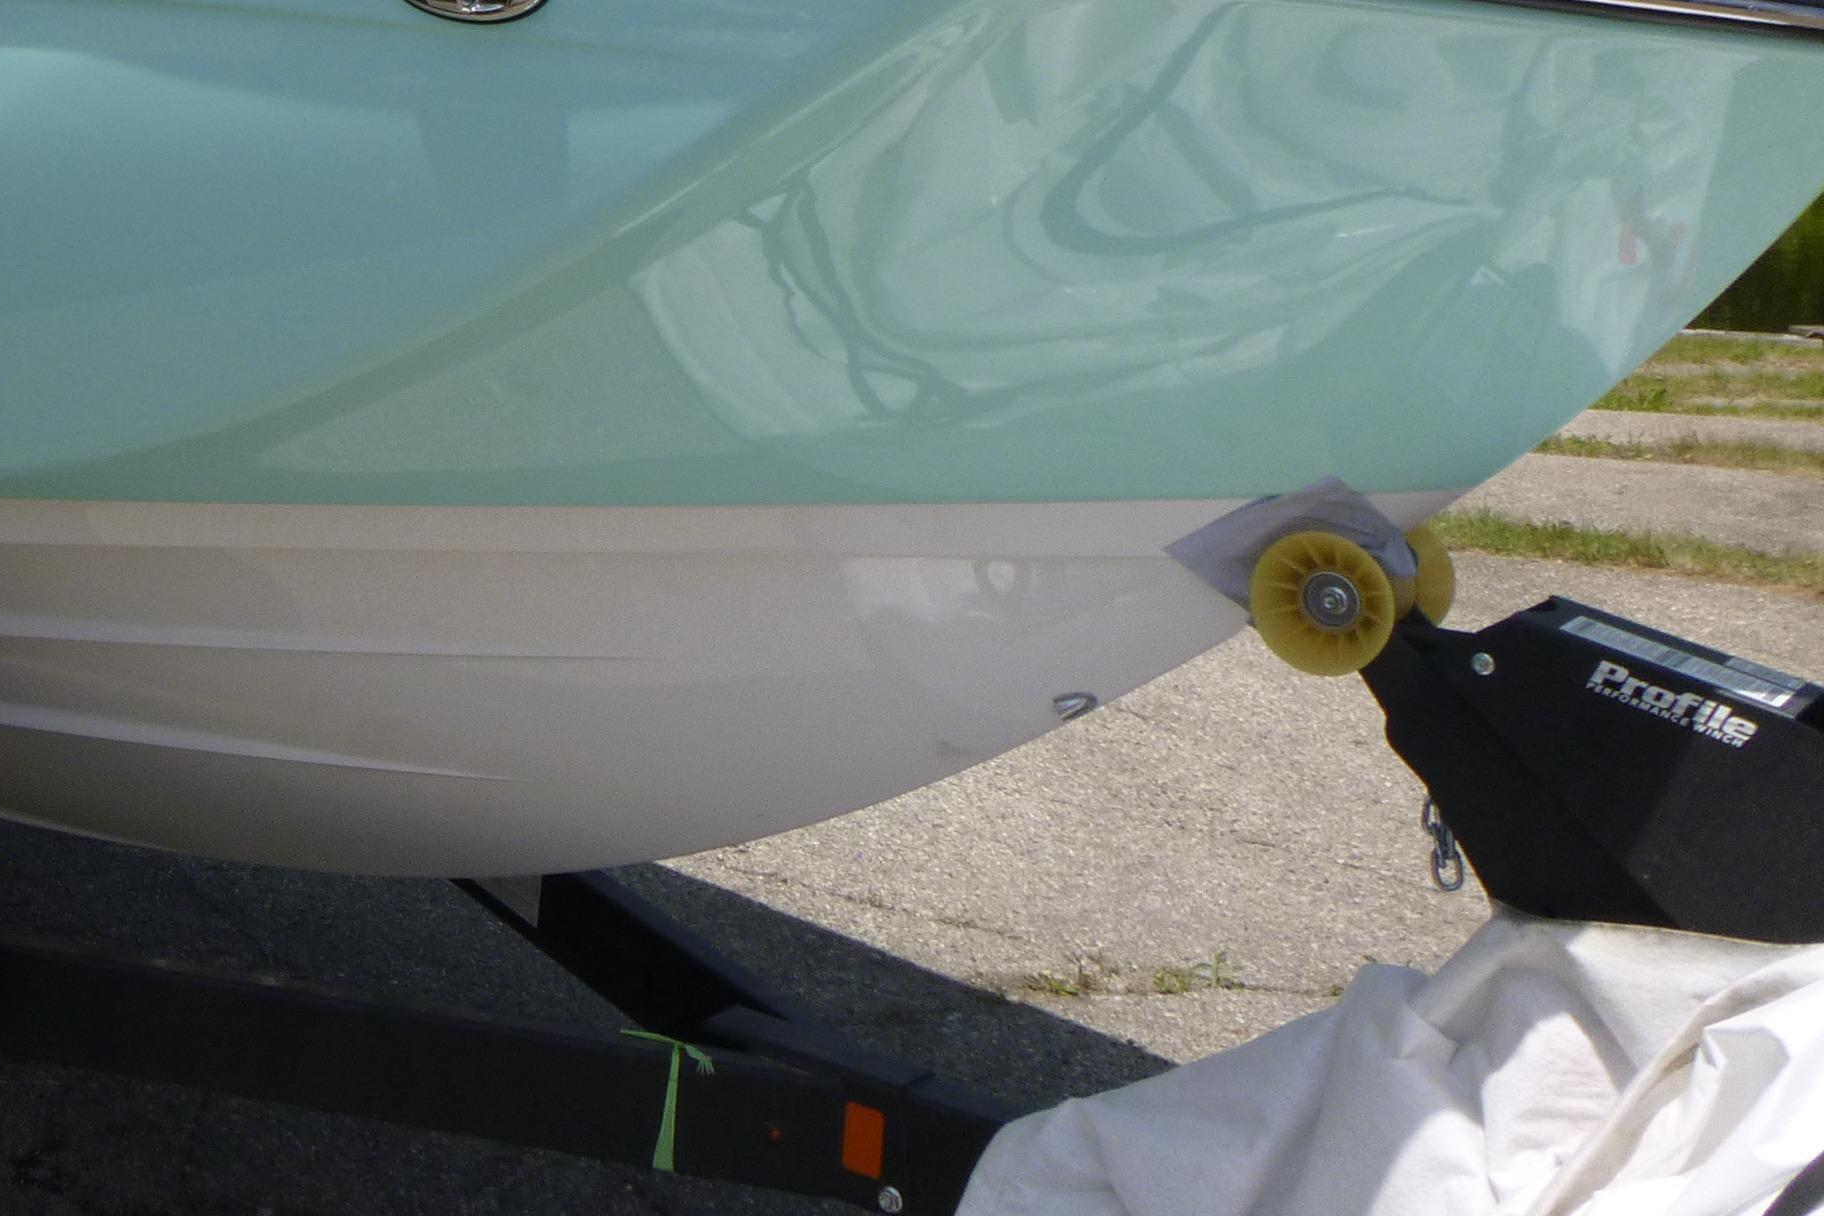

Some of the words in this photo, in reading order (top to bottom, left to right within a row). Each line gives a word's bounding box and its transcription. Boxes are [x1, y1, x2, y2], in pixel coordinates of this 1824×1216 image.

[1585, 681, 1690, 727] PERFORMANCE
[1693, 722, 1746, 748] WINCH
[1590, 660, 1759, 740] Profile
